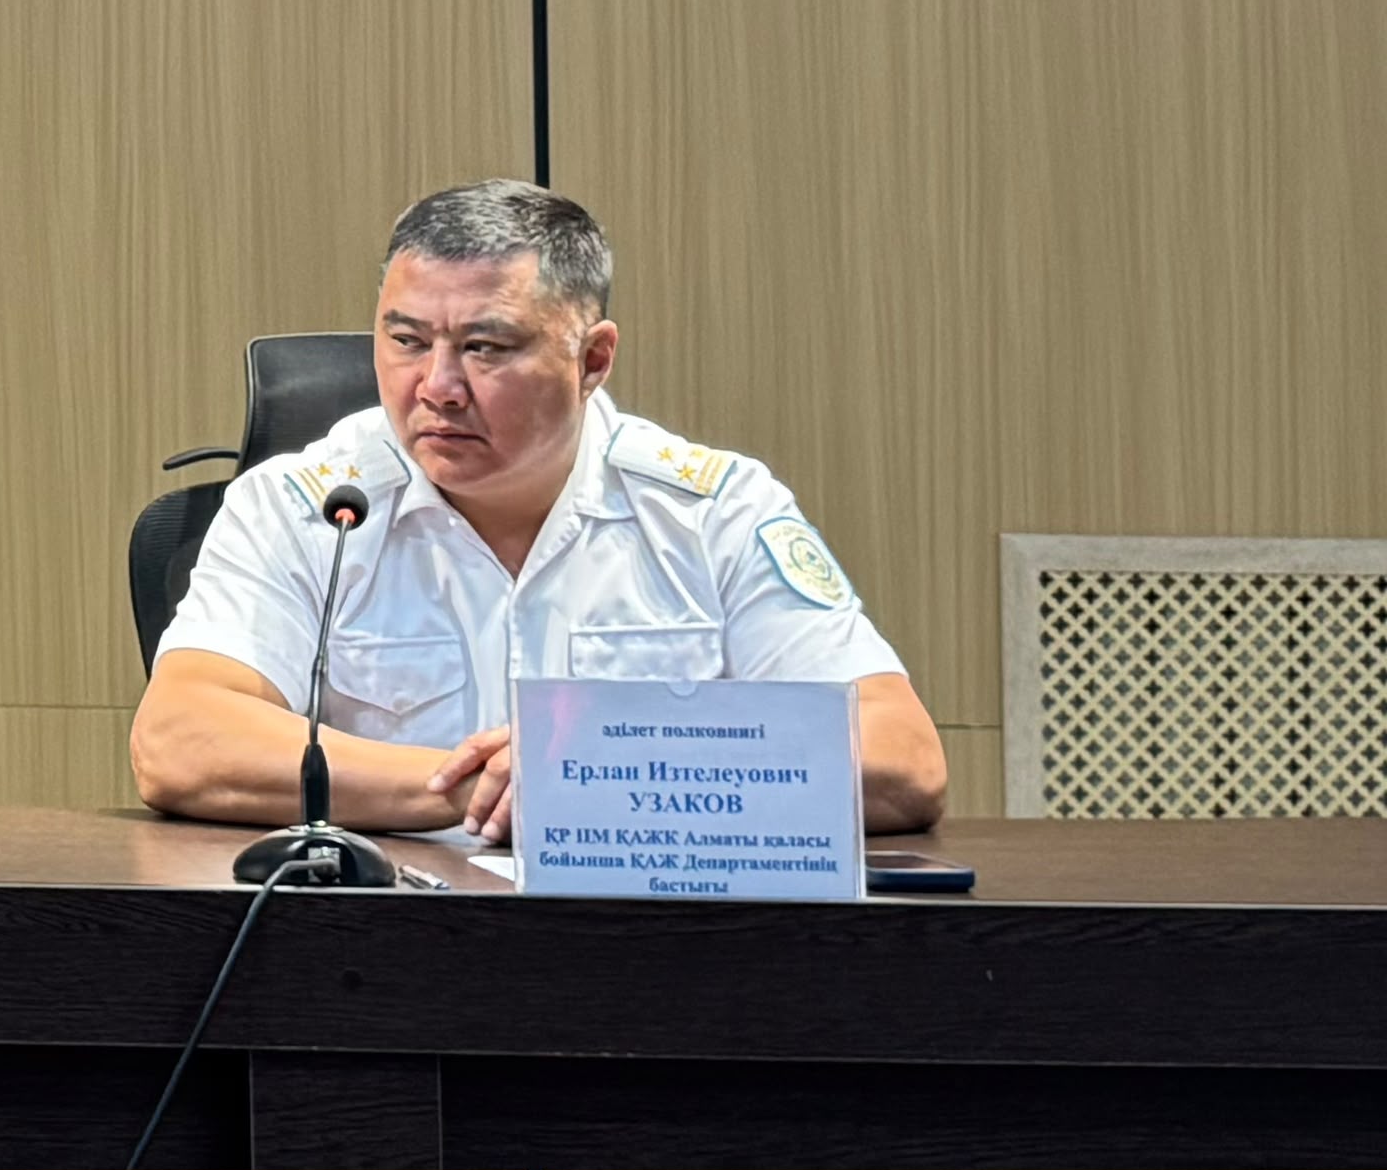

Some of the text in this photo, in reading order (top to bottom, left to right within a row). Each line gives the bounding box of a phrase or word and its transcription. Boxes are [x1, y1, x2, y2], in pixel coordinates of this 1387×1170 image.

[602, 722, 766, 740] әділет полковнигі
[562, 760, 809, 788] Ерлан Изтелеуович
[629, 792, 745, 814] УЗАКОВ
[545, 827, 571, 846] ҚР
[616, 828, 680, 847] ҚАЖК
[684, 830, 758, 847] Алматы
[763, 834, 831, 848] қаласы
[539, 851, 839, 874] бойынша ҚАЖ Департаментінің
[648, 877, 729, 894] бастығы
